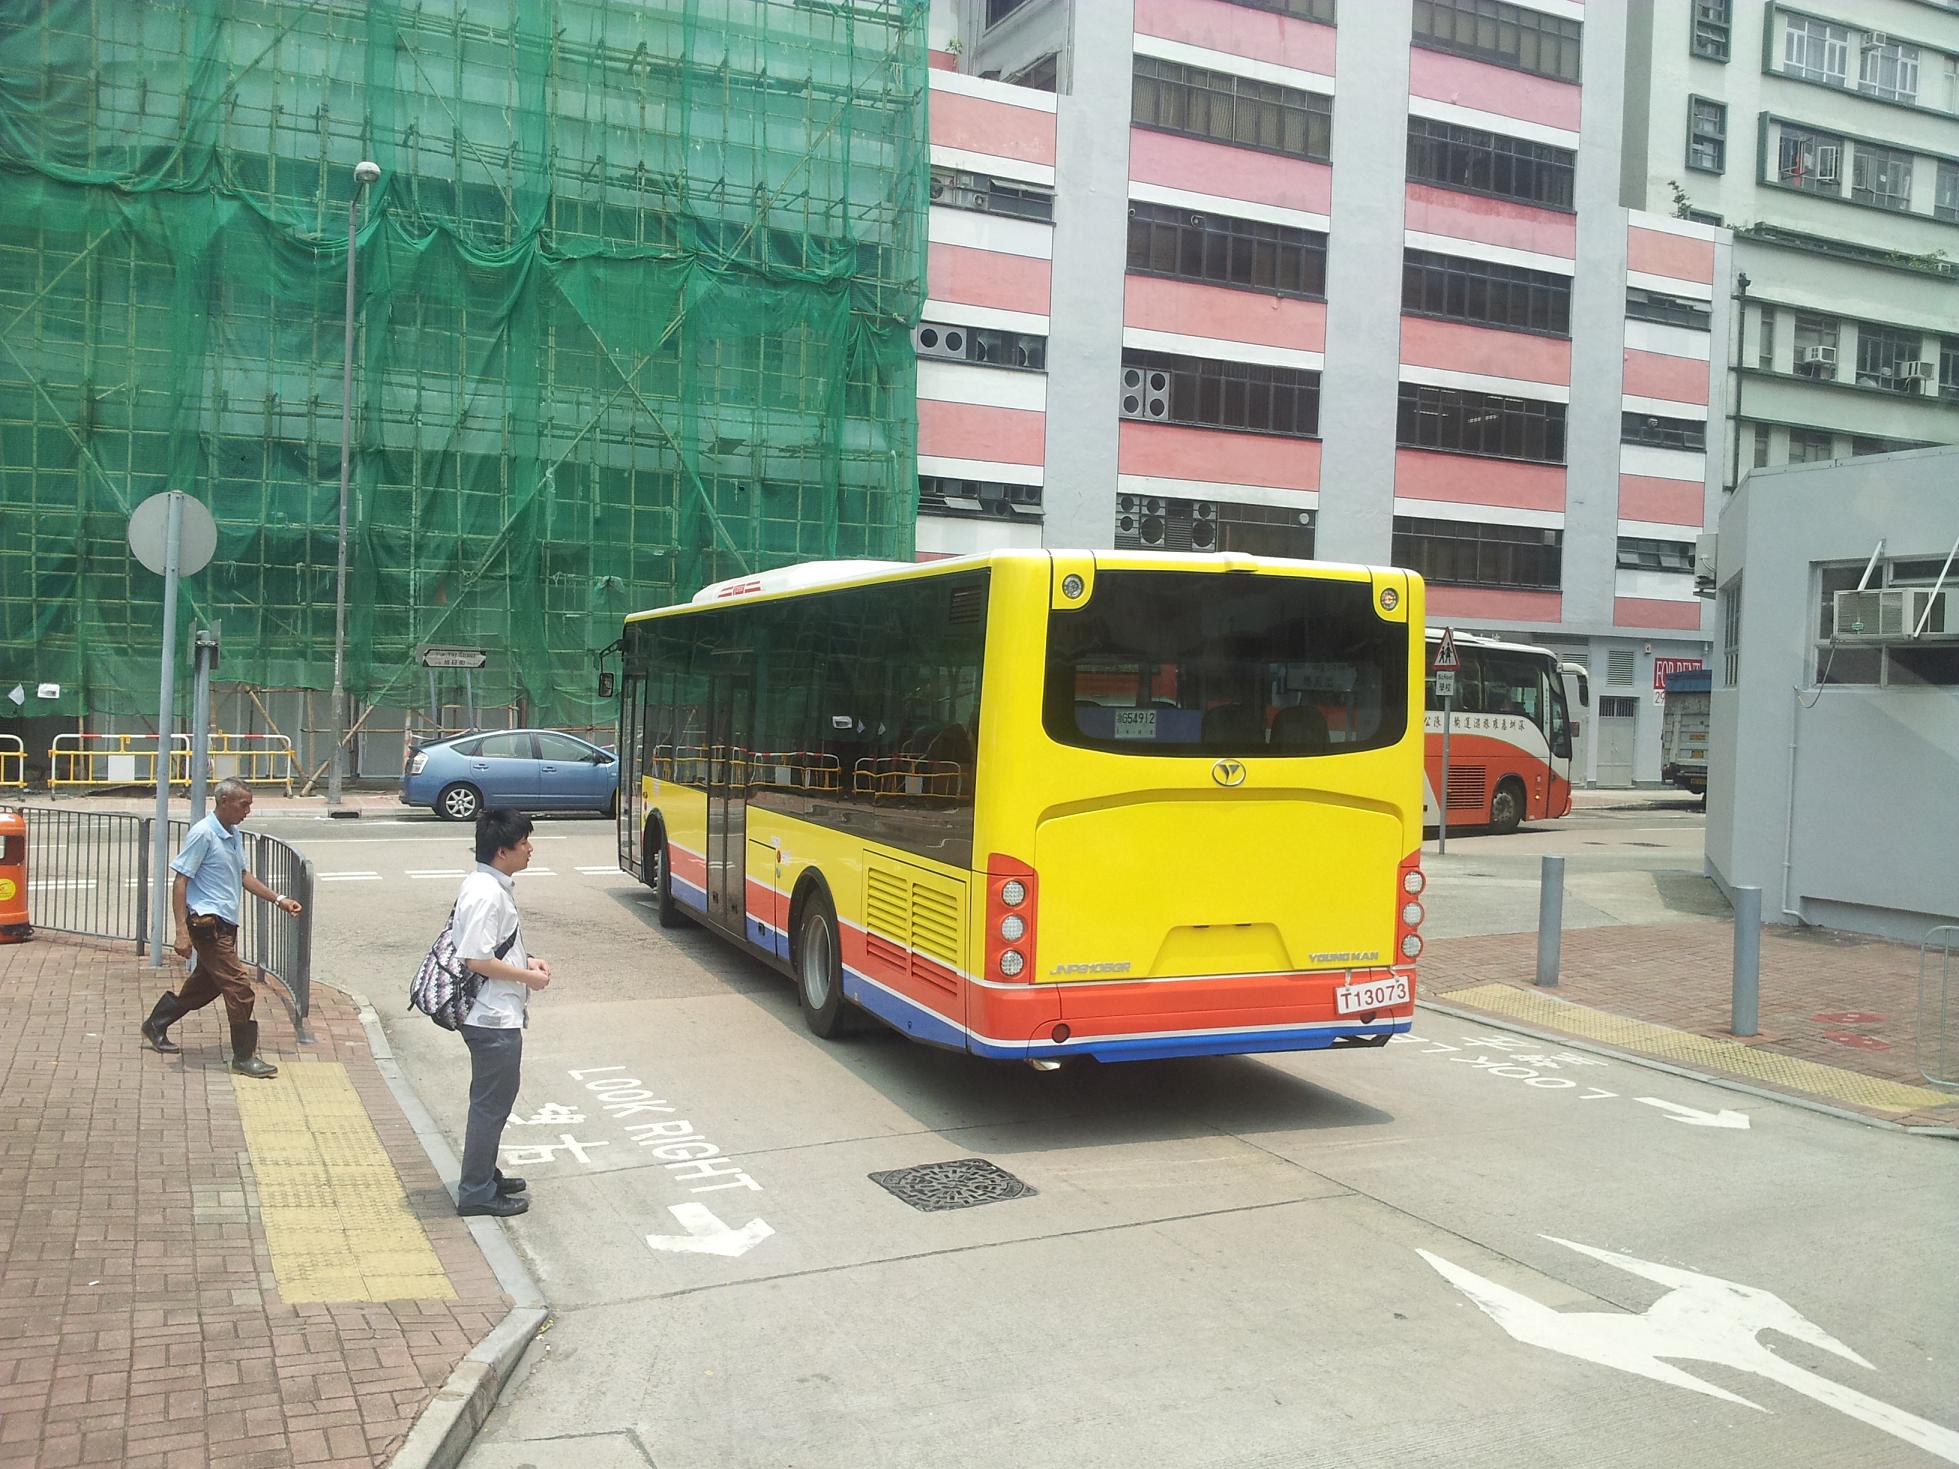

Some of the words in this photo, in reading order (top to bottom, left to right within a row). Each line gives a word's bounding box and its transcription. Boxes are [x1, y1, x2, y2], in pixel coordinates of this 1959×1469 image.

[1341, 983, 1406, 1009] T13073
[1389, 1033, 1462, 1053] LE
[1450, 1056, 1618, 1099] LOOK
[568, 1065, 676, 1118] LOOK
[624, 1119, 764, 1193] RIGHT
